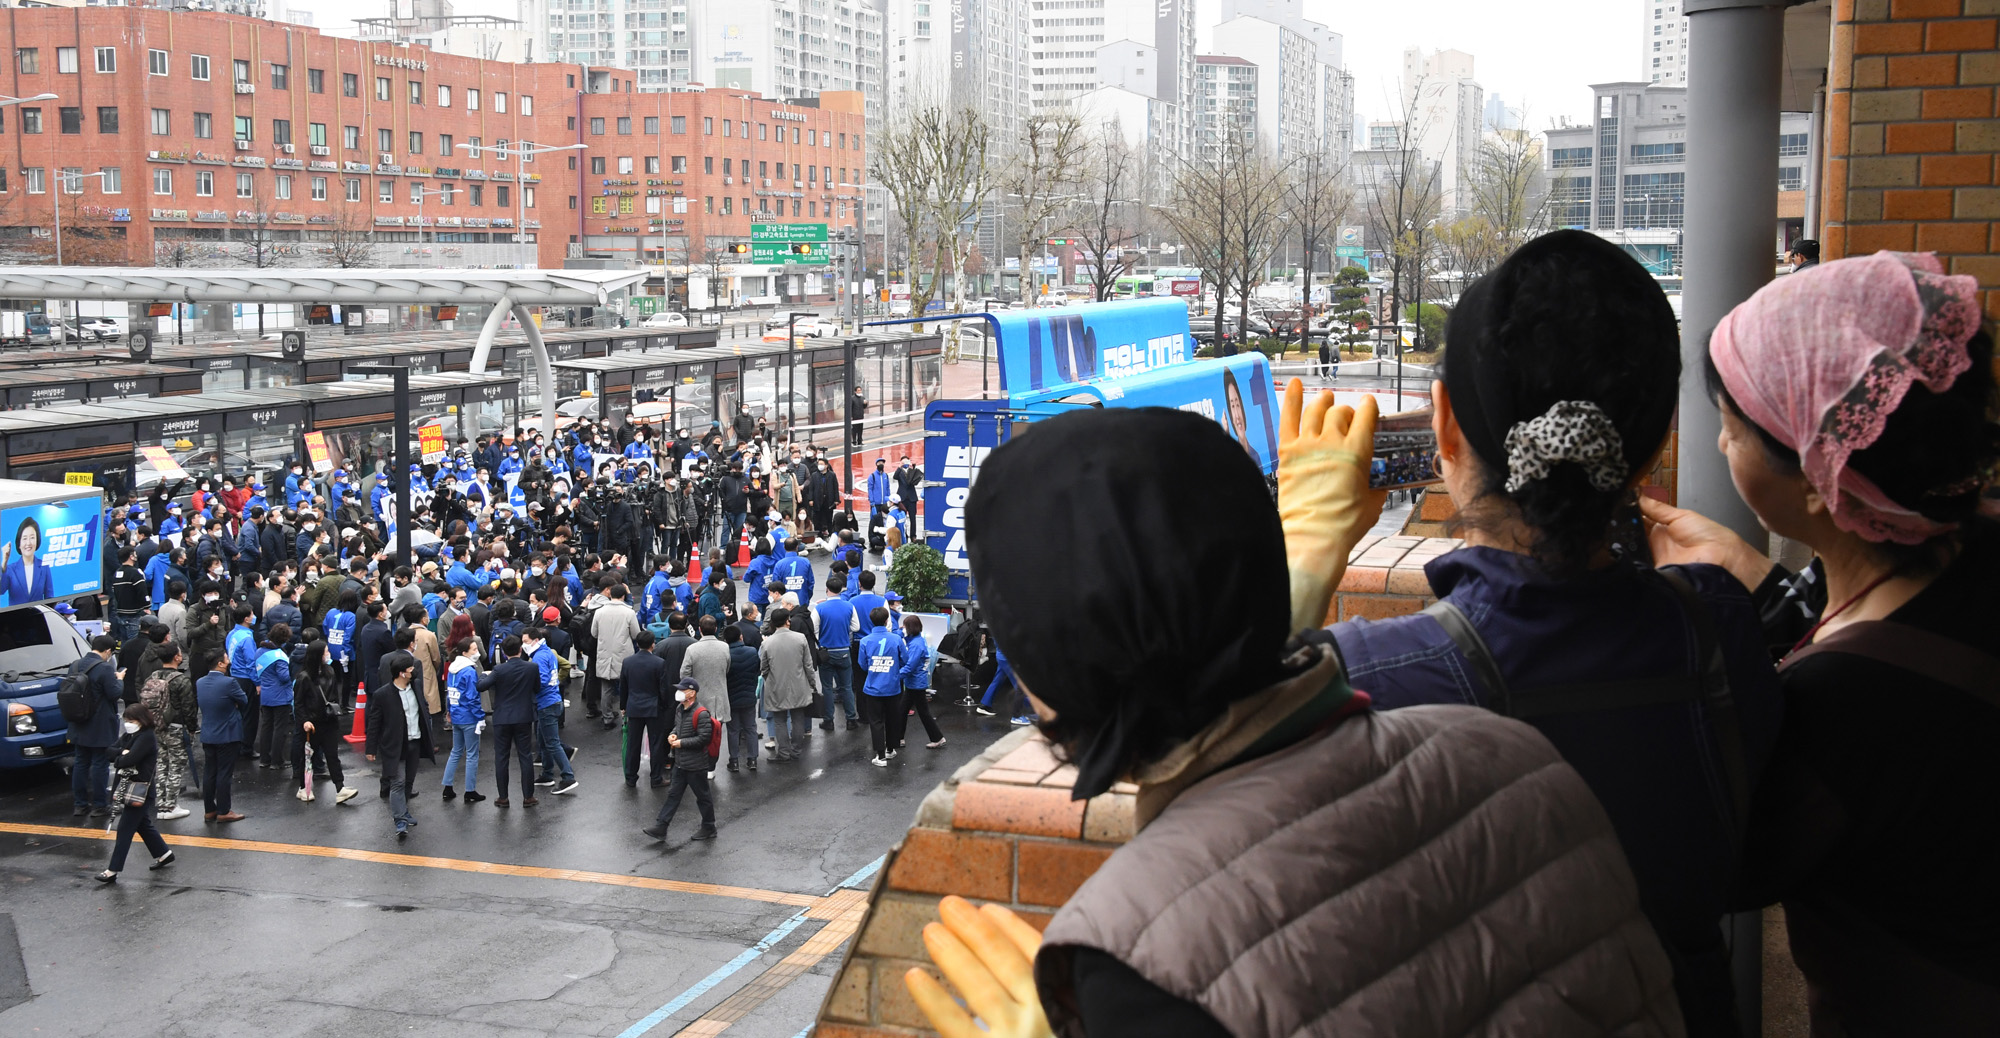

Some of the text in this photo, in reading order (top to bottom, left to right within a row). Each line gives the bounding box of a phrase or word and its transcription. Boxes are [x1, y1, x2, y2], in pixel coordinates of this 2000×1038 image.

[954, 50, 963, 69] 105
[760, 231, 789, 239] 경부고속도로
[32, 388, 65, 397] 고속터미널경부선
[114, 381, 136, 391] 택시승차
[483, 387, 501, 396] 택시승차
[252, 410, 277, 421] 택시승차
[163, 419, 199, 431] 고속터미널경부선
[306, 434, 325, 445] 구역지정
[419, 426, 442, 440] 구역지정
[422, 440, 443, 454] 철회!!
[49, 532, 87, 552] 합니다
[84, 514, 99, 561] 1
[41, 549, 80, 567] 박영선
[790, 561, 797, 576] 1
[333, 613, 342, 629] 1
[878, 637, 887, 656] 1
